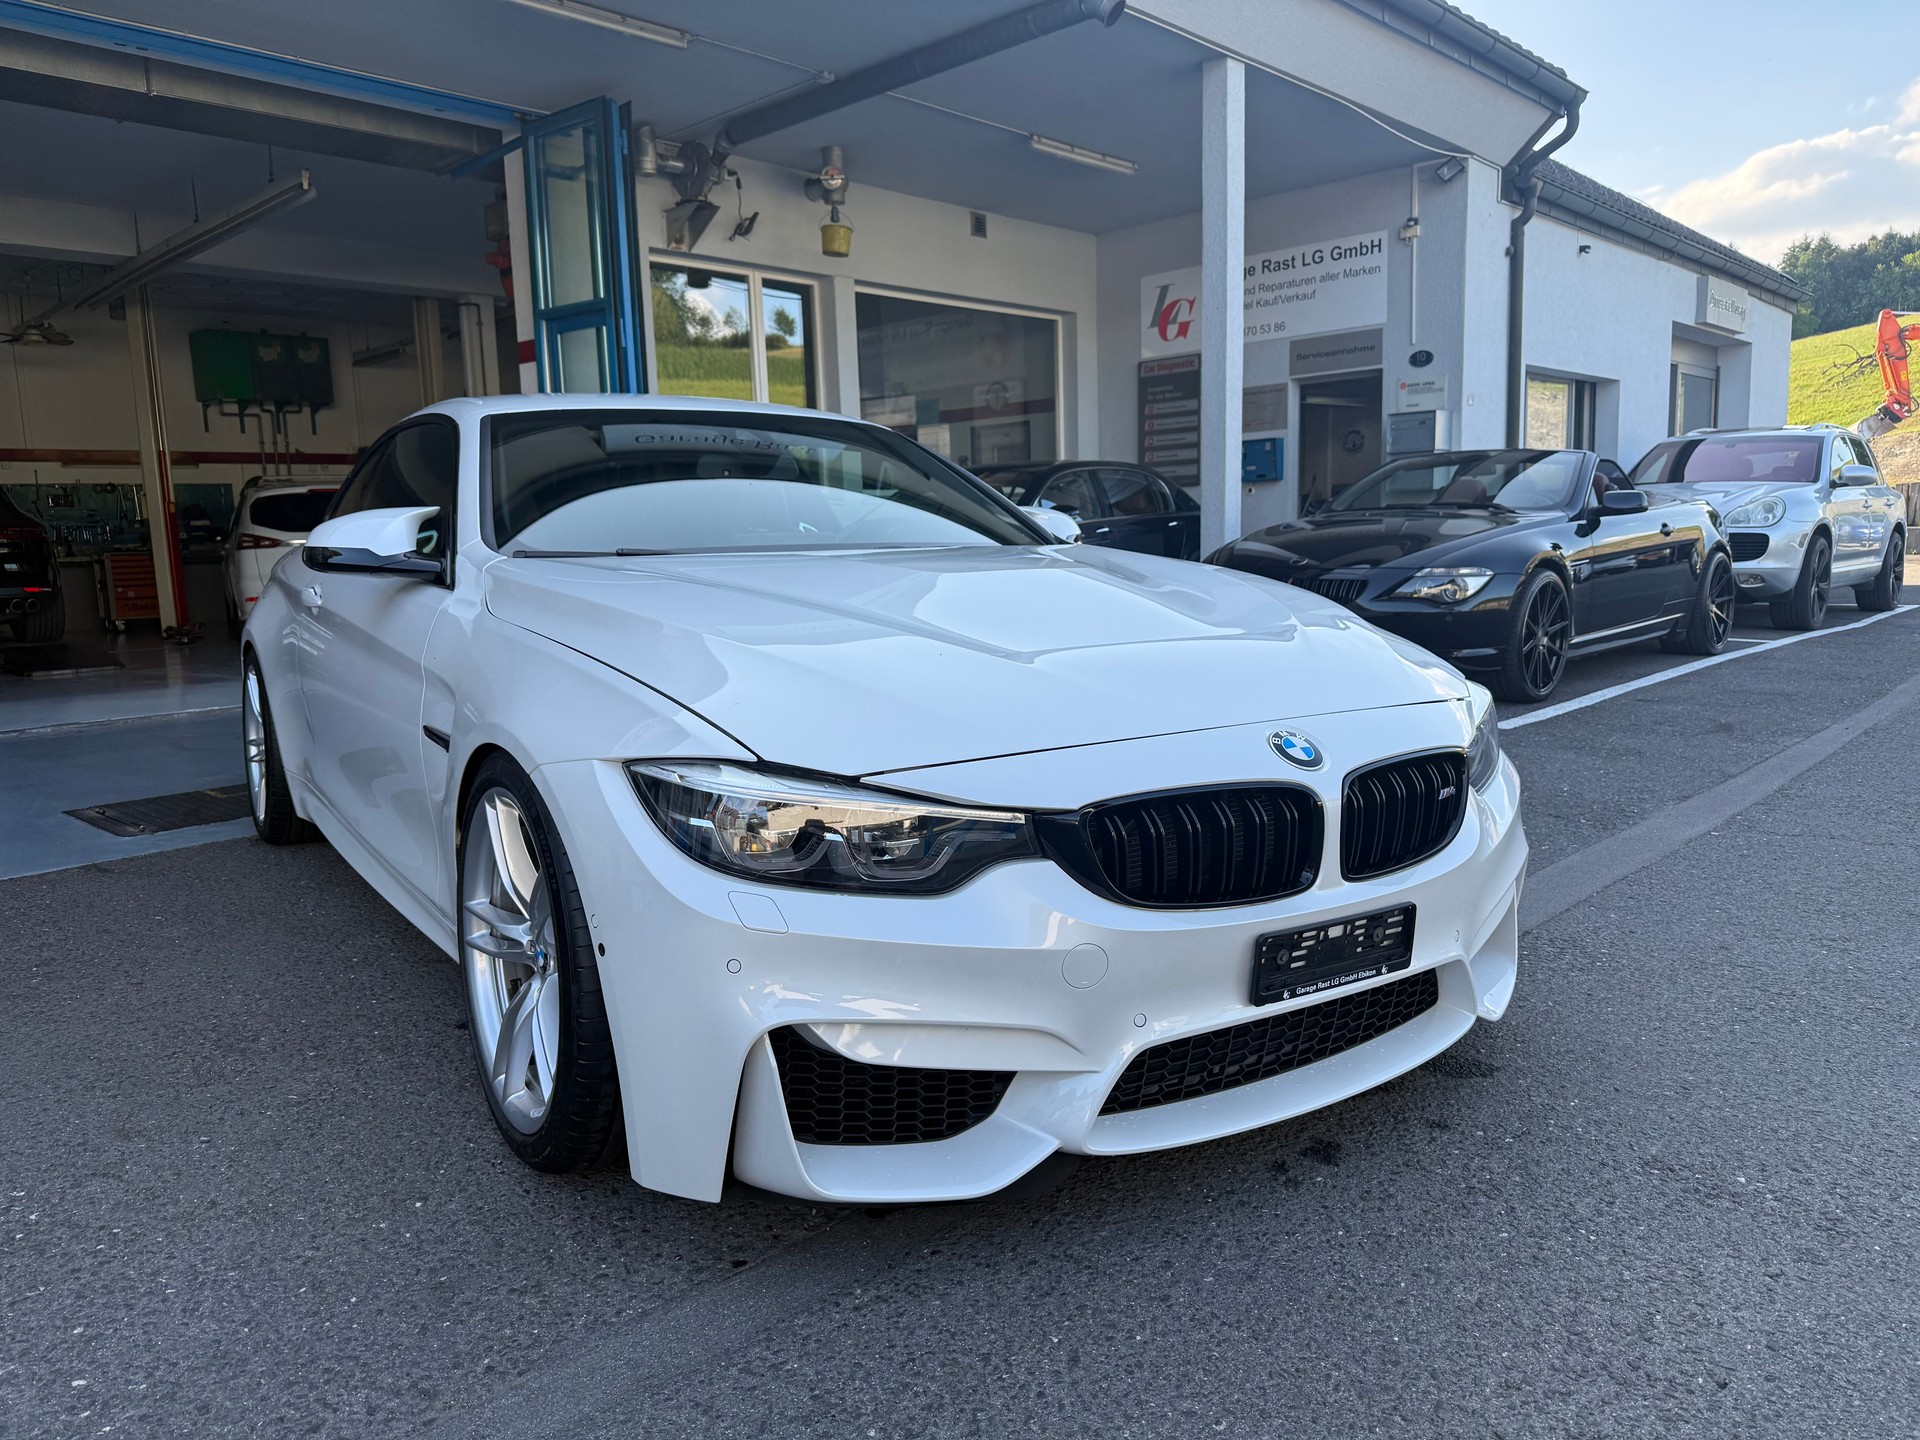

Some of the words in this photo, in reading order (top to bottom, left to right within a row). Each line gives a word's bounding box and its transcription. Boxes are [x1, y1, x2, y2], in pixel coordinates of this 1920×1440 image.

[1261, 254, 1296, 274] Rast
[1302, 249, 1324, 267] LG
[1330, 238, 1382, 261] GmbH
[1258, 276, 1316, 294] Reparaturen
[1319, 271, 1340, 284] aller
[1343, 265, 1381, 279] Marken
[1255, 289, 1317, 309] Kauf/Verkauf
[1259, 323, 1271, 335] 53
[1273, 321, 1286, 332] 86
[1296, 344, 1376, 361] Serviceannahme
[1416, 351, 1427, 362] 10
[1296, 985, 1317, 995] Garage
[1317, 980, 1331, 989] Rast
[1331, 977, 1339, 986] LG
[1339, 973, 1358, 984] GmbH
[1358, 969, 1377, 979] Ebikon
